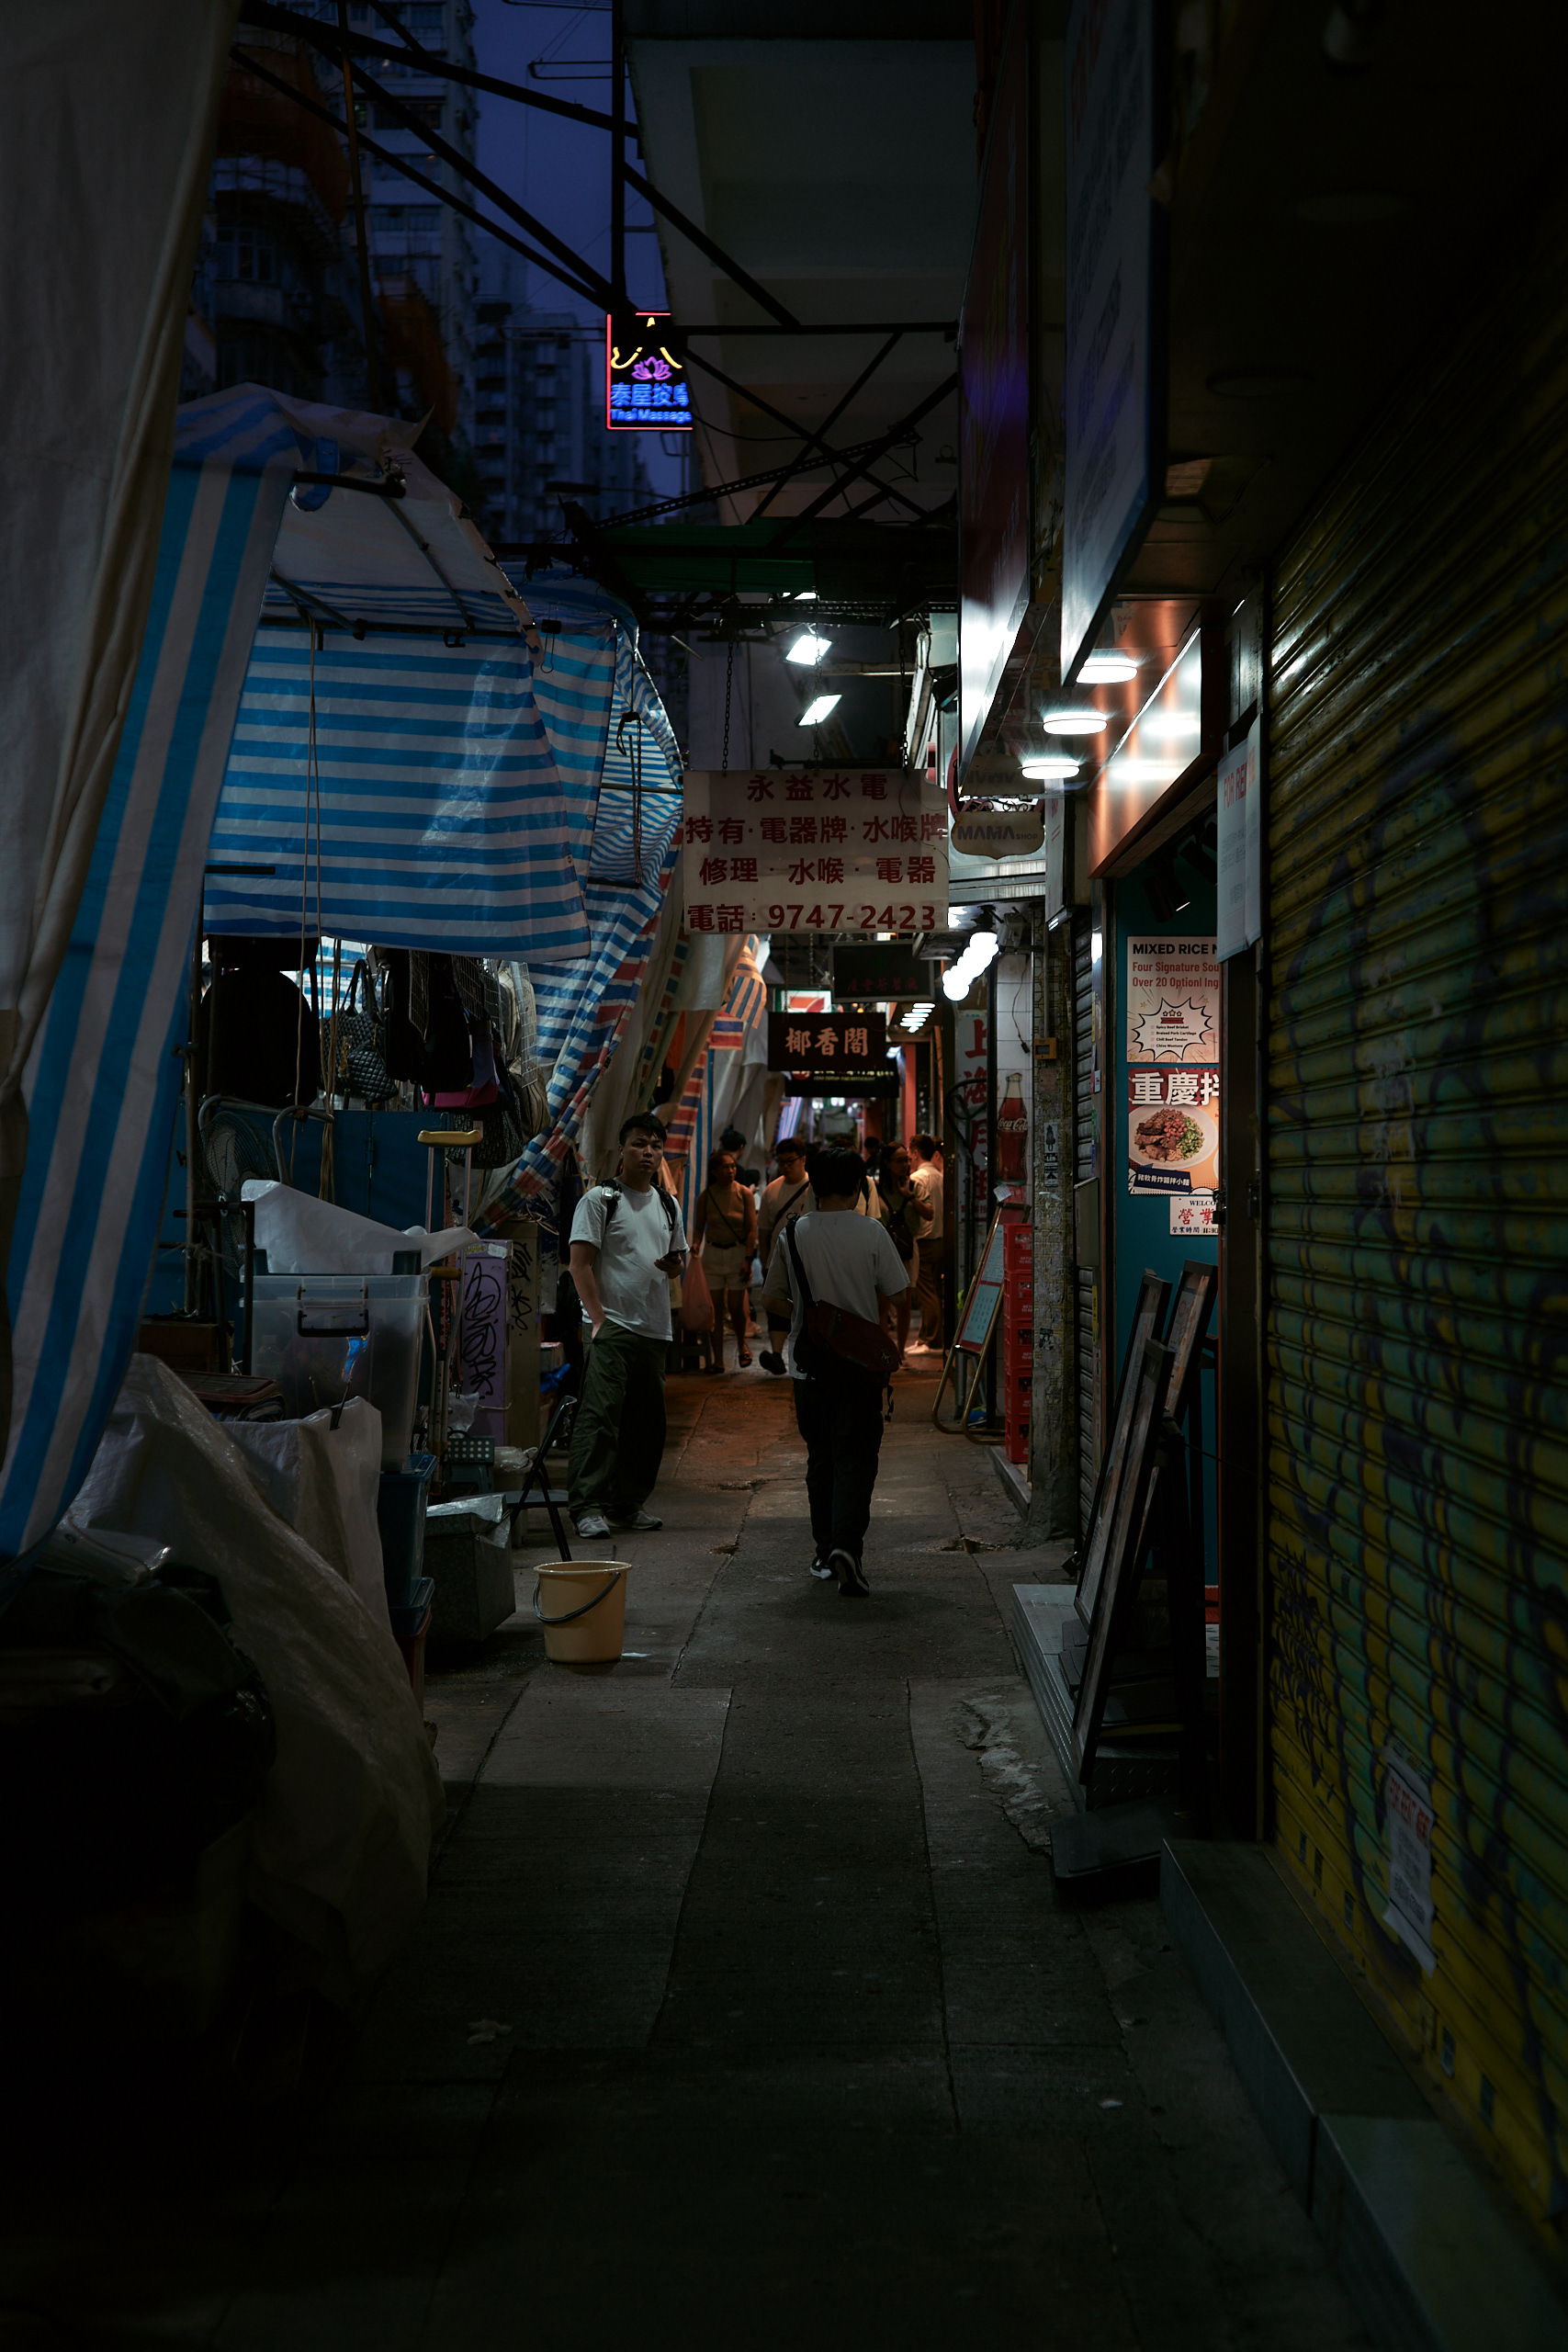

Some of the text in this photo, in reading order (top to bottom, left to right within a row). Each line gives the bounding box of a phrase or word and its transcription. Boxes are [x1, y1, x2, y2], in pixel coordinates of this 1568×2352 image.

[610, 408, 693, 424] Thai Massage
[747, 773, 887, 802] 永益水電
[957, 826, 1015, 840] MAMA
[768, 904, 935, 930] 9747-2423
[1133, 944, 1175, 955] MIXED
[1179, 944, 1209, 955] RICE
[1133, 962, 1153, 972] Four
[1156, 962, 1200, 974] Signature
[1133, 977, 1153, 987] Over
[1156, 977, 1168, 987] 20
[784, 1026, 869, 1057] 椰香閣
